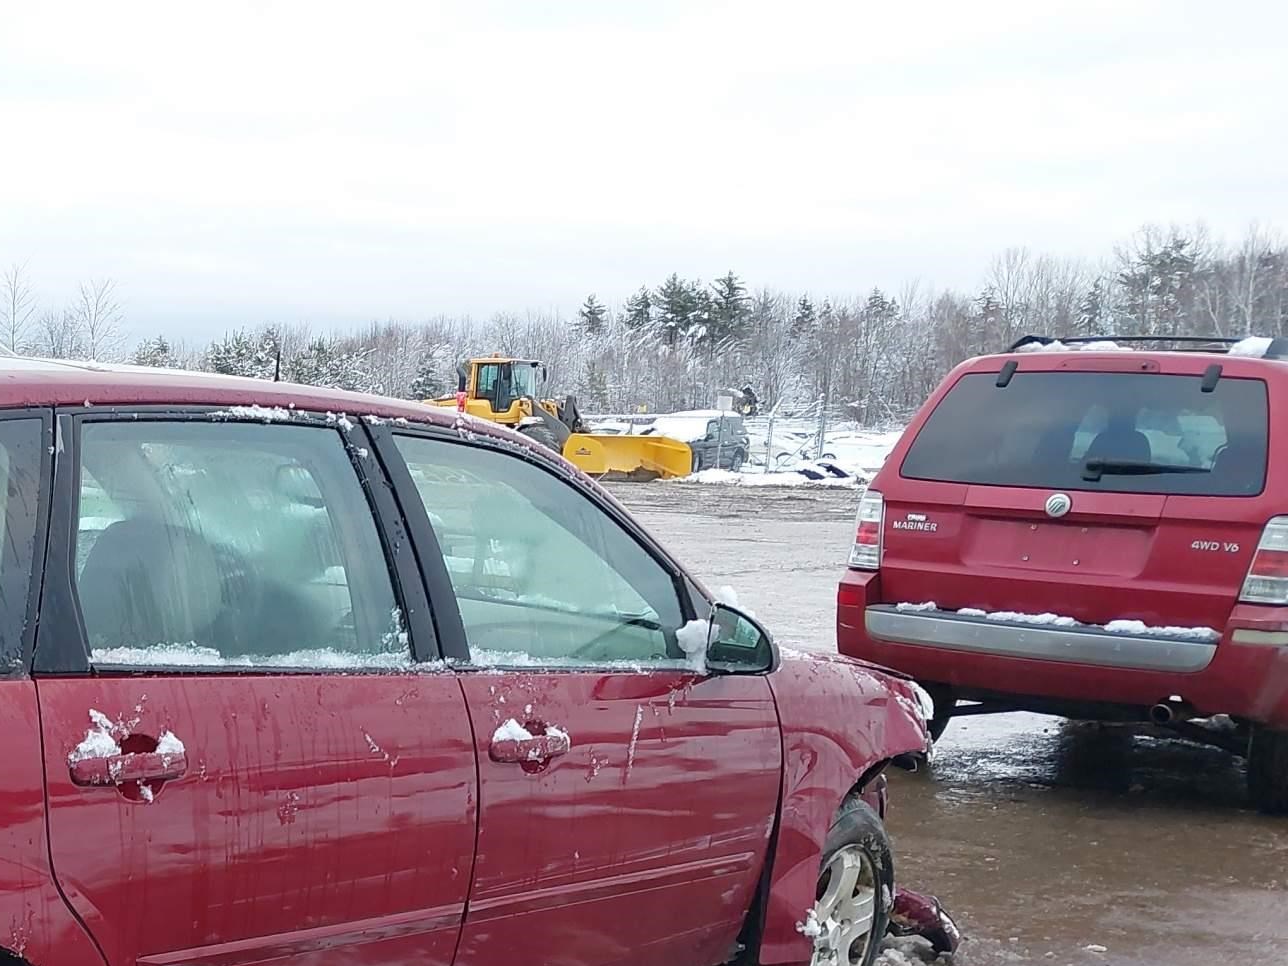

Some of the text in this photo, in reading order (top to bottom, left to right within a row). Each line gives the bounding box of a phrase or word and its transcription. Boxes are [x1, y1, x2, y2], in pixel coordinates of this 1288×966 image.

[892, 520, 938, 532] MARINER
[1191, 540, 1240, 553] 4WD V6
